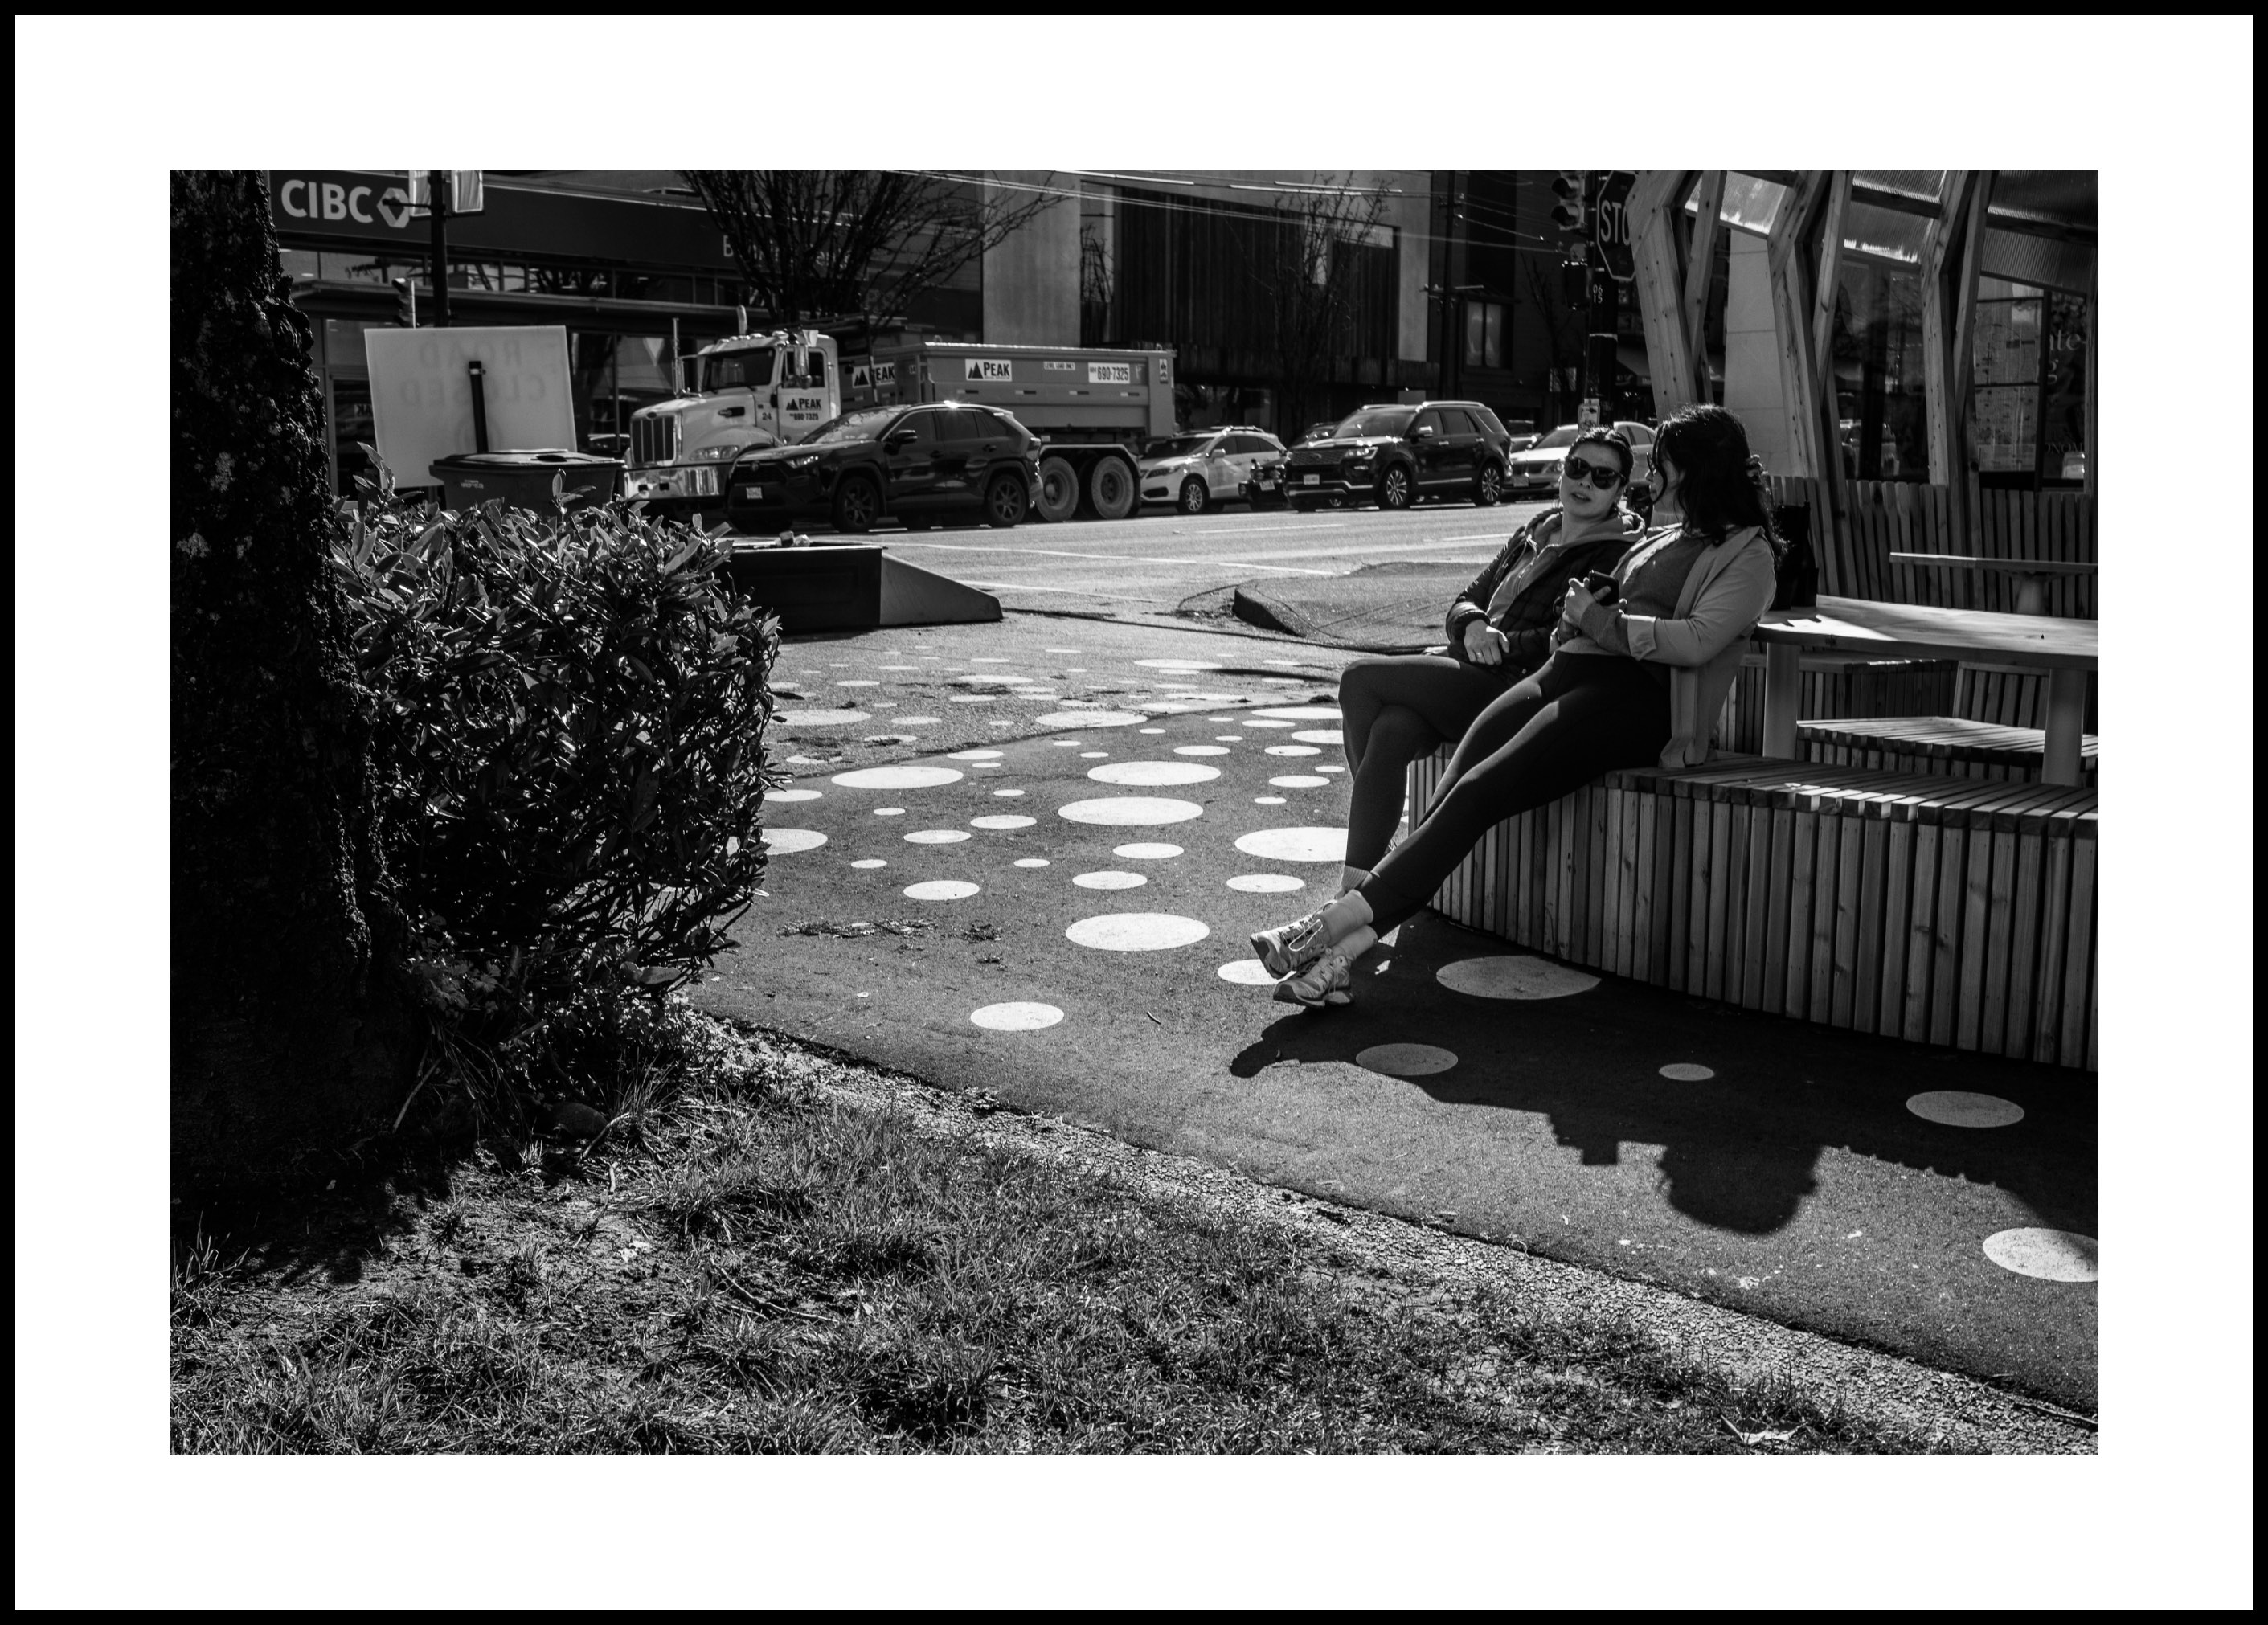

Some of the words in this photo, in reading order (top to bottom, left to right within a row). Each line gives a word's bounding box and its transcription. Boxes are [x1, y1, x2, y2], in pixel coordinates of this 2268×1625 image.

[281, 179, 374, 223] CIBC
[1600, 199, 1631, 246] STO
[874, 366, 895, 381] EAK
[983, 362, 1010, 376] PEAK
[1098, 366, 1129, 380] 690-7325
[799, 398, 822, 408] PEAK
[762, 412, 772, 420] 24
